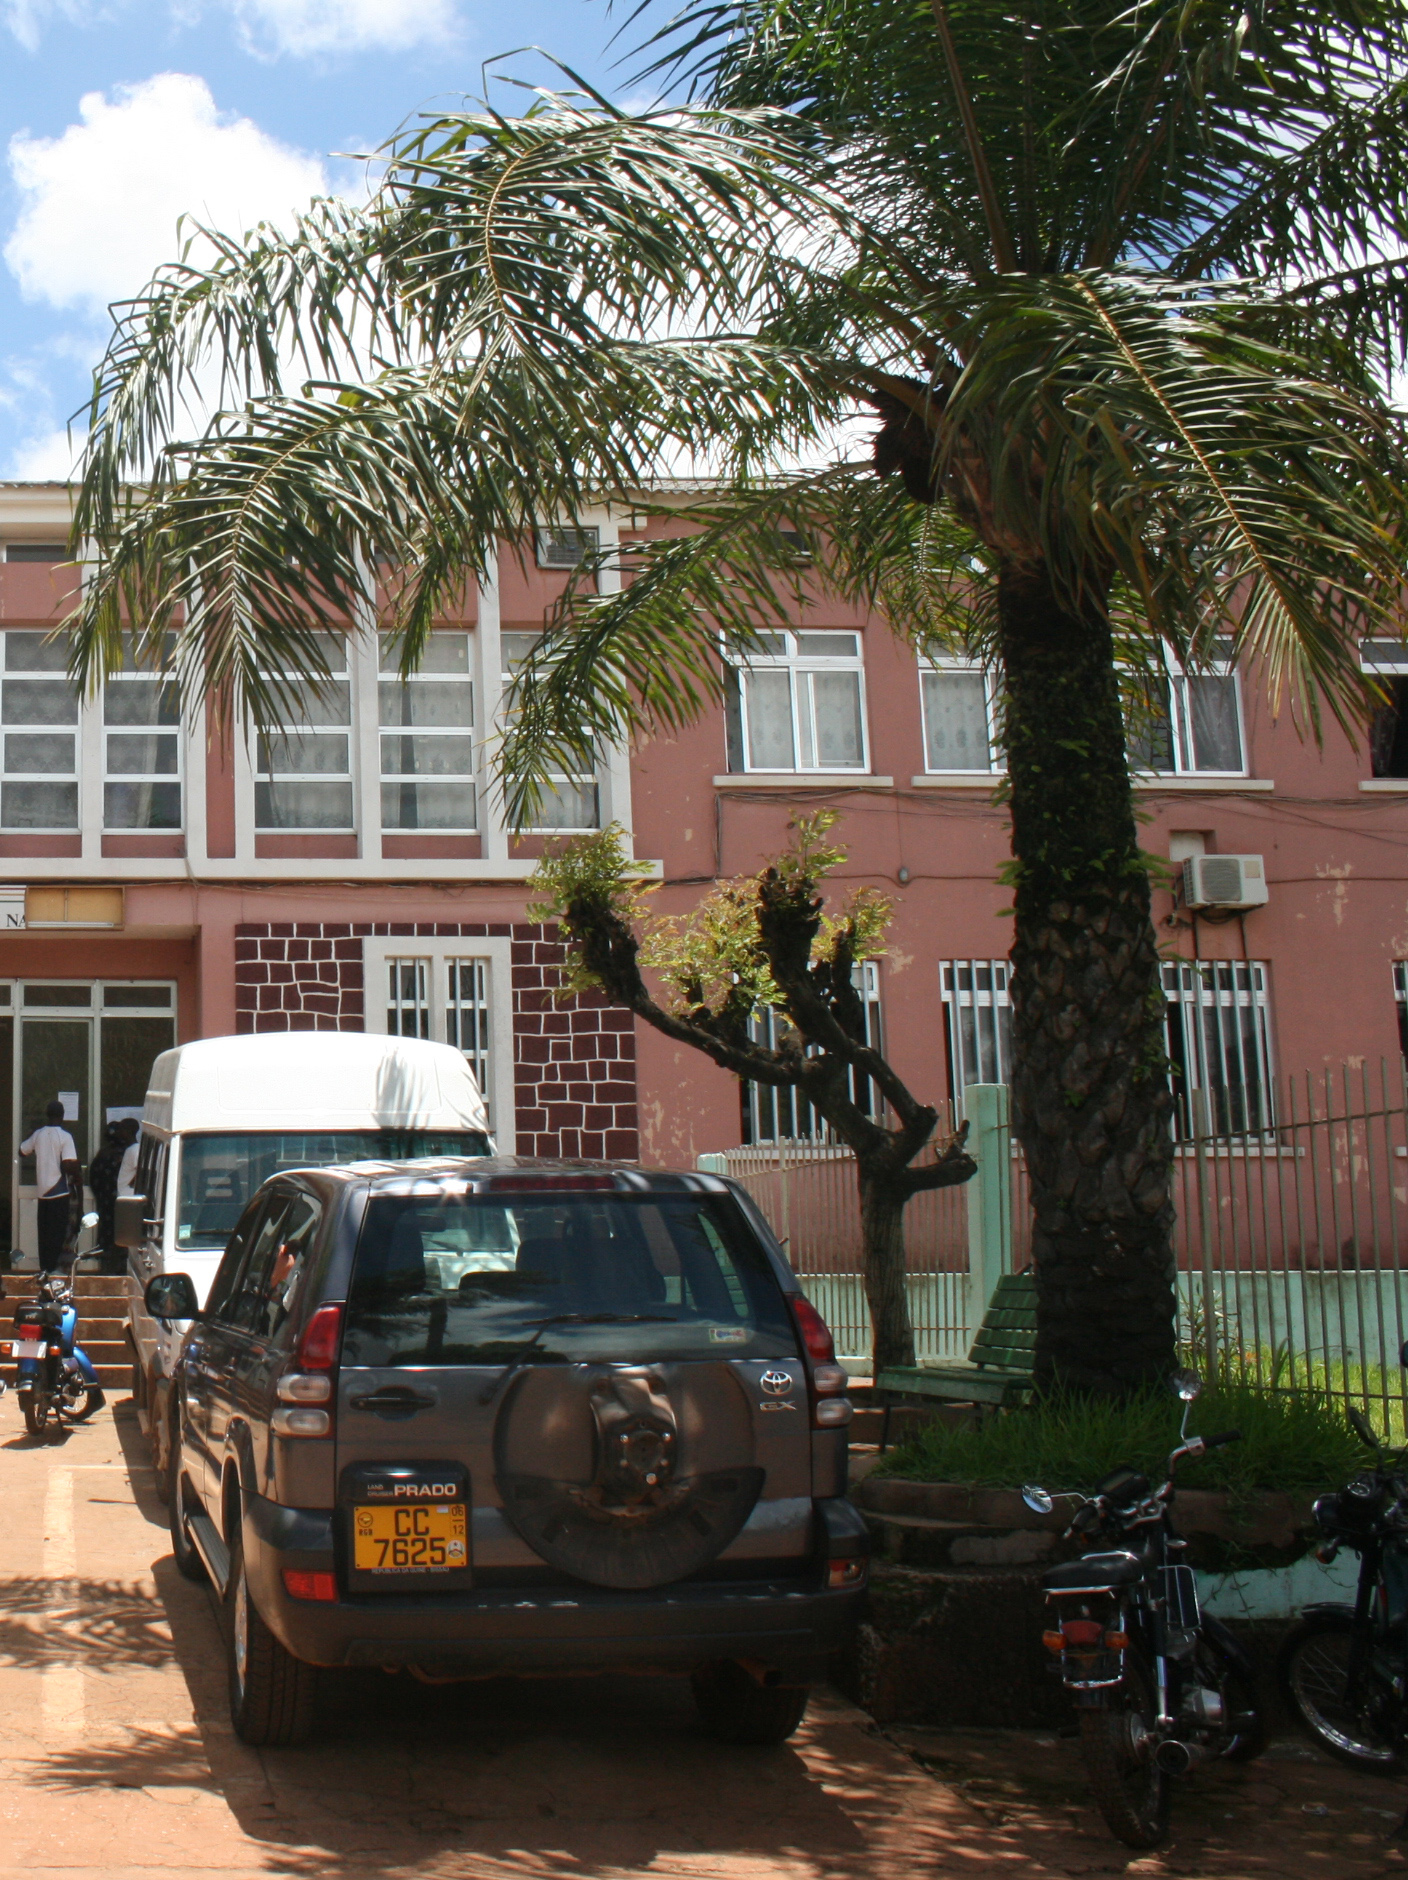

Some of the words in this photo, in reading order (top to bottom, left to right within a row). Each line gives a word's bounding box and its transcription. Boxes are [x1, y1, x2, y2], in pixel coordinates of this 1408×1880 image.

[394, 1483, 457, 1496] PRADO
[451, 1506, 464, 1516] 06
[394, 1508, 430, 1537] CC
[453, 1524, 464, 1535] 12
[373, 1537, 446, 1567] 7625
